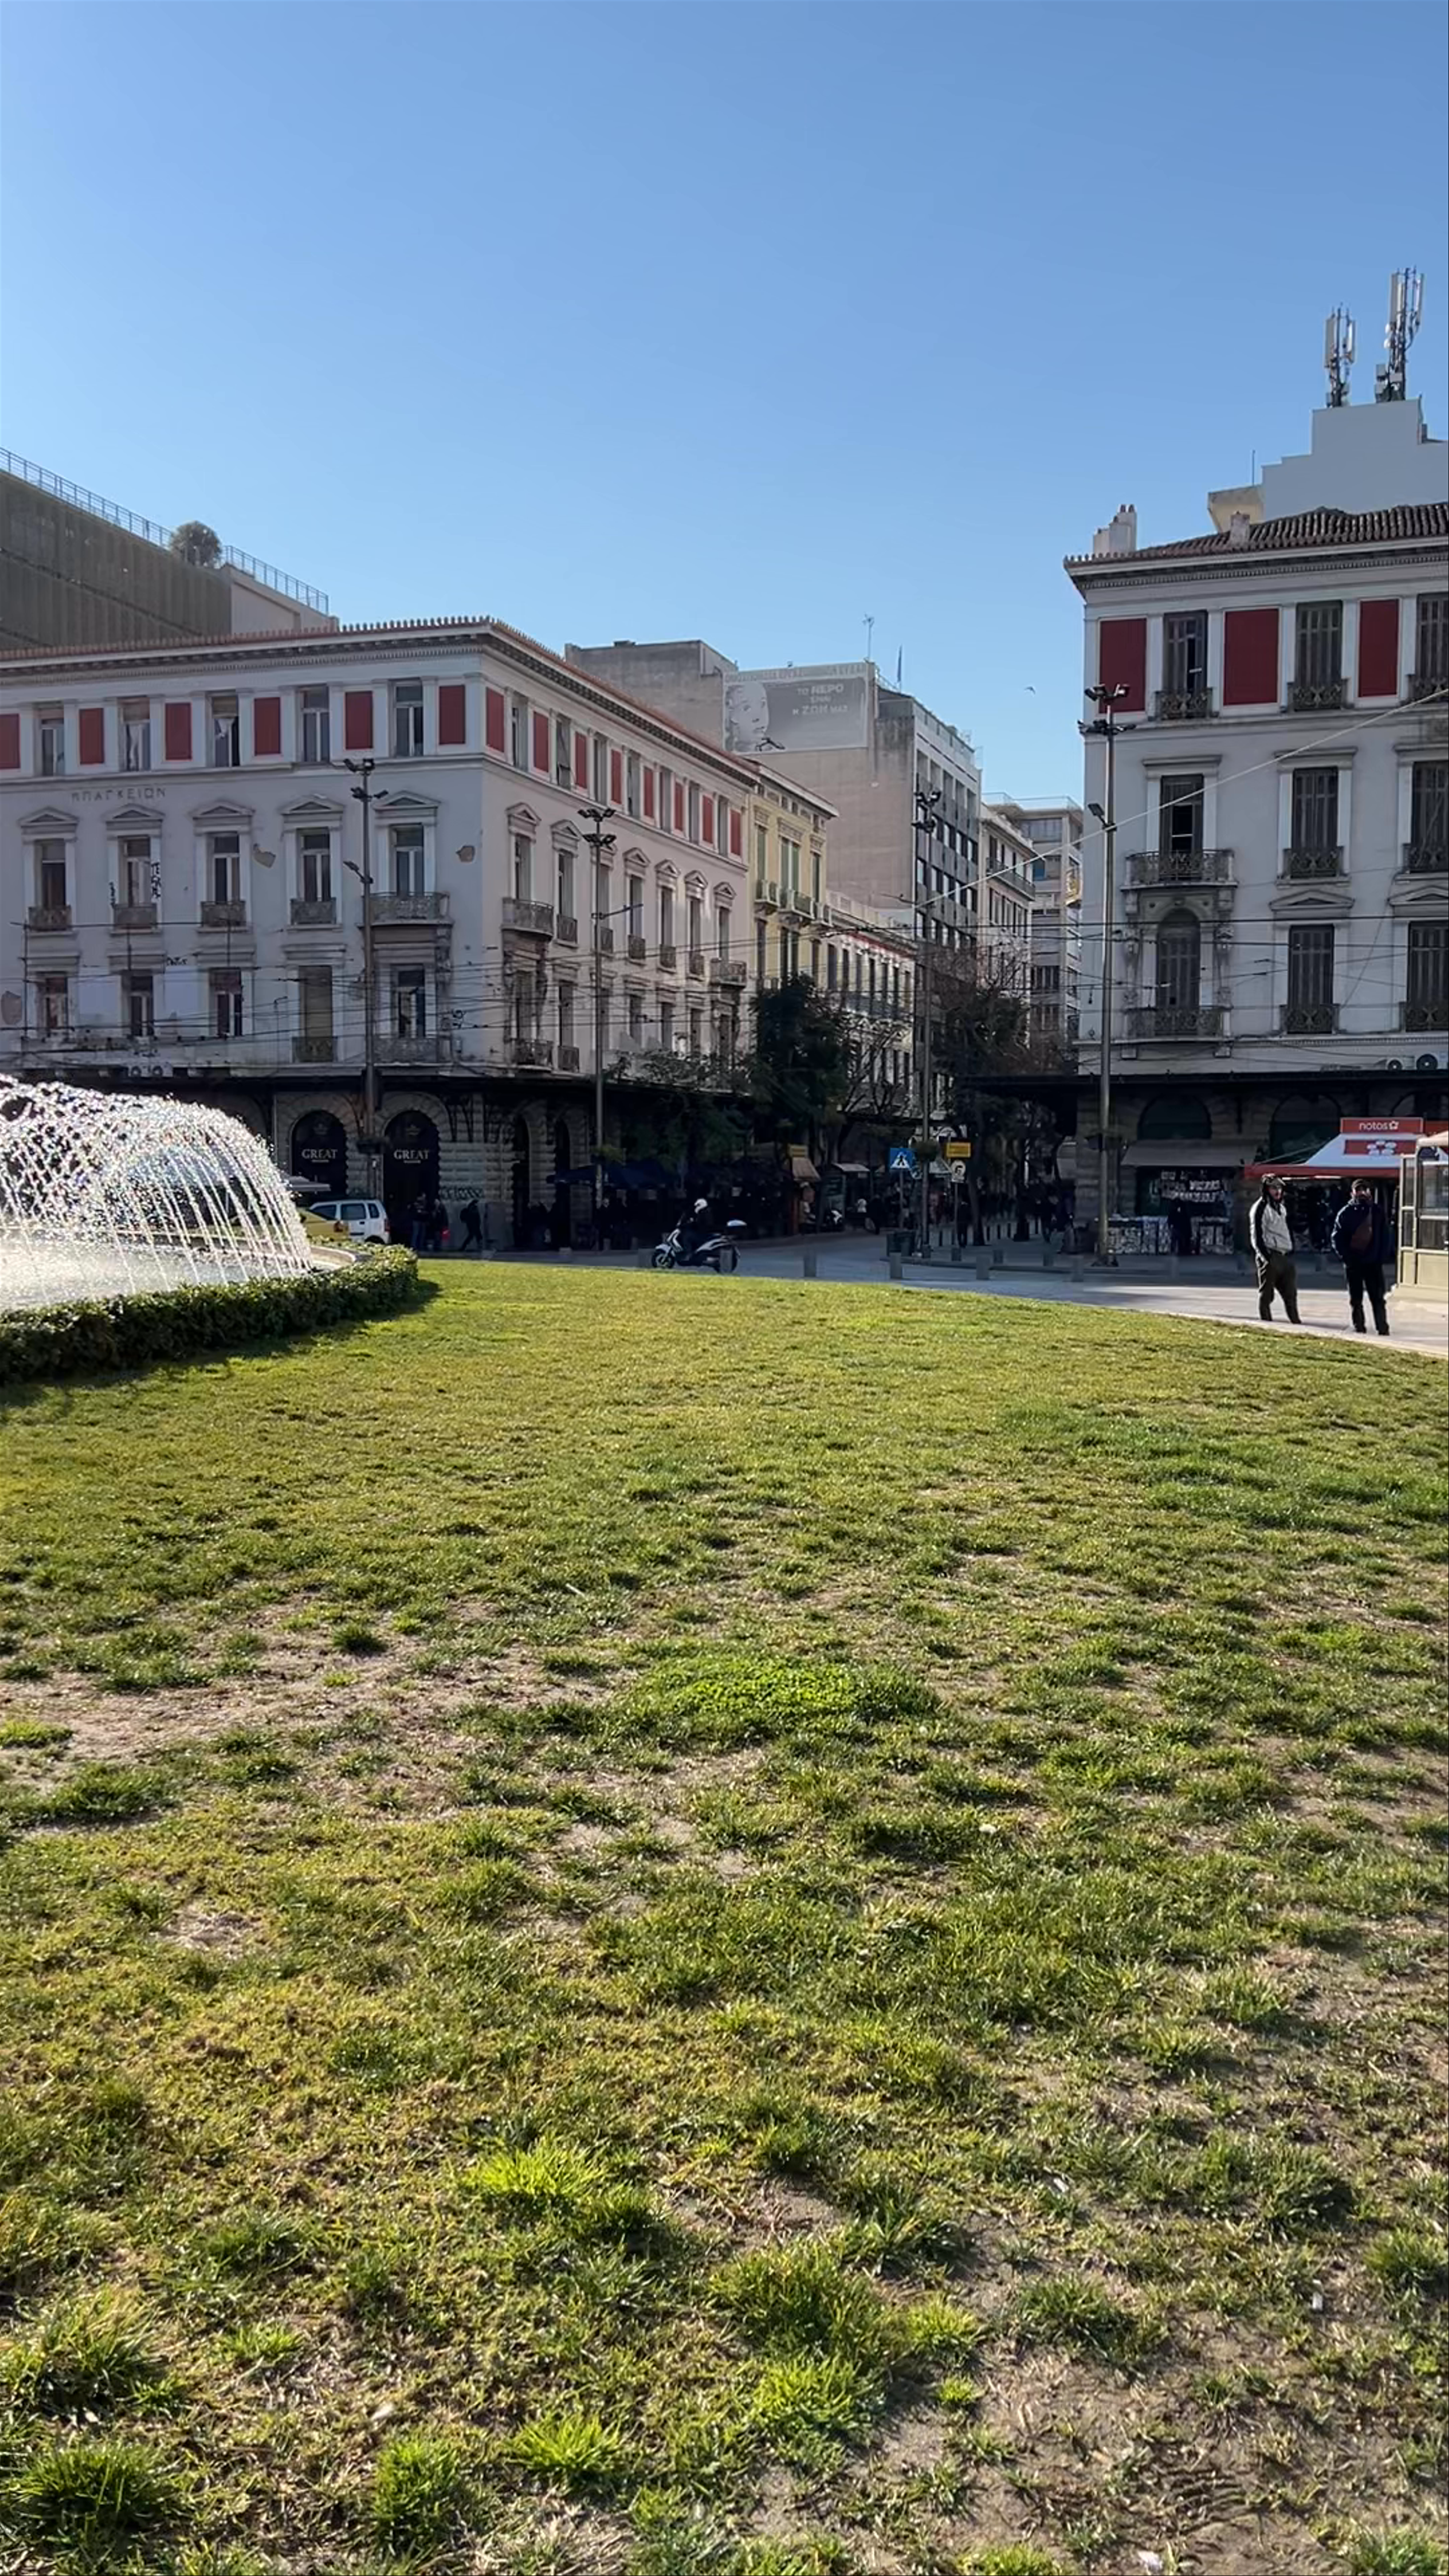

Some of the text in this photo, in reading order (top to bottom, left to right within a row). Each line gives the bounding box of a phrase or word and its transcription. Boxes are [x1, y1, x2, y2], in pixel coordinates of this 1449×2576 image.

[1360, 1121, 1387, 1130] notos
[301, 1149, 338, 1159] GREAT
[394, 1149, 429, 1159] GREAT
